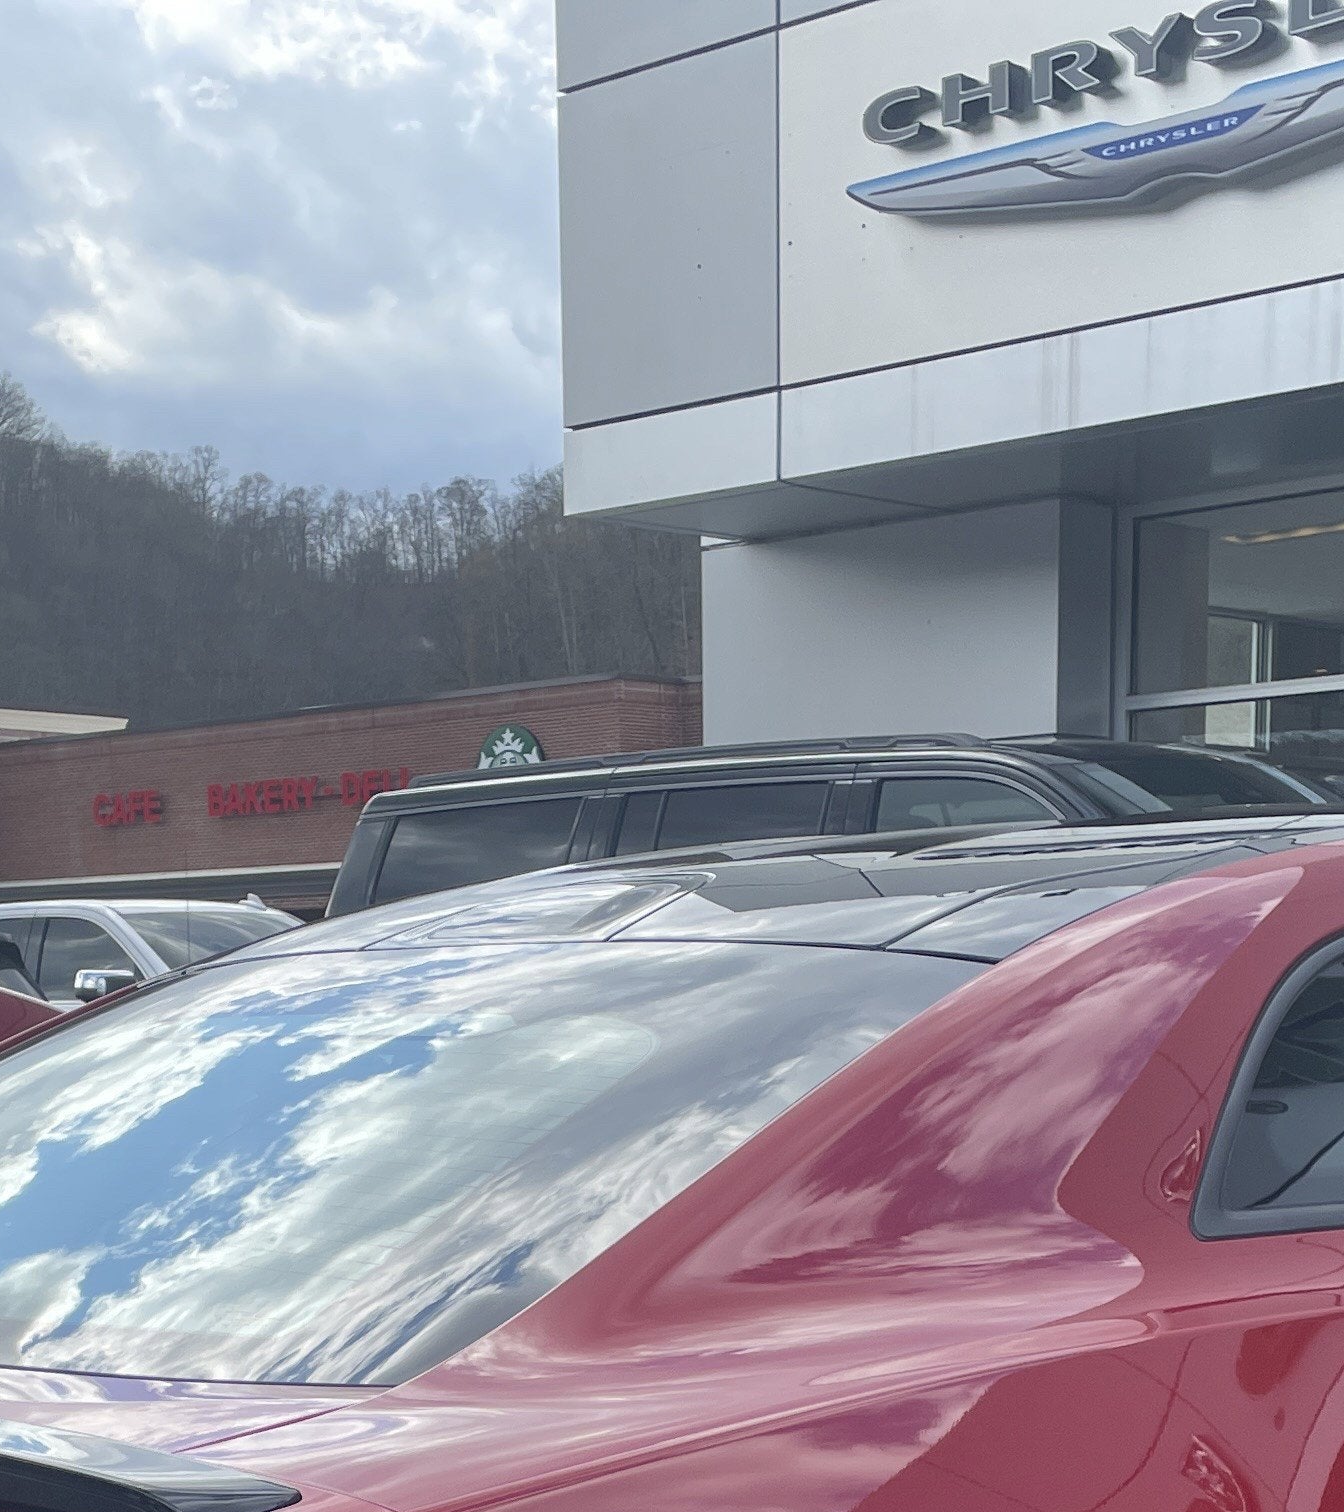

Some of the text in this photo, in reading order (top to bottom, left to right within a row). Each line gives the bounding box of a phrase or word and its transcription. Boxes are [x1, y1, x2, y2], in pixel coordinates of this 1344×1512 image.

[1102, 116, 1238, 157] CHRYSLER
[93, 790, 160, 827] CAFE
[208, 774, 319, 818] BAKERY
